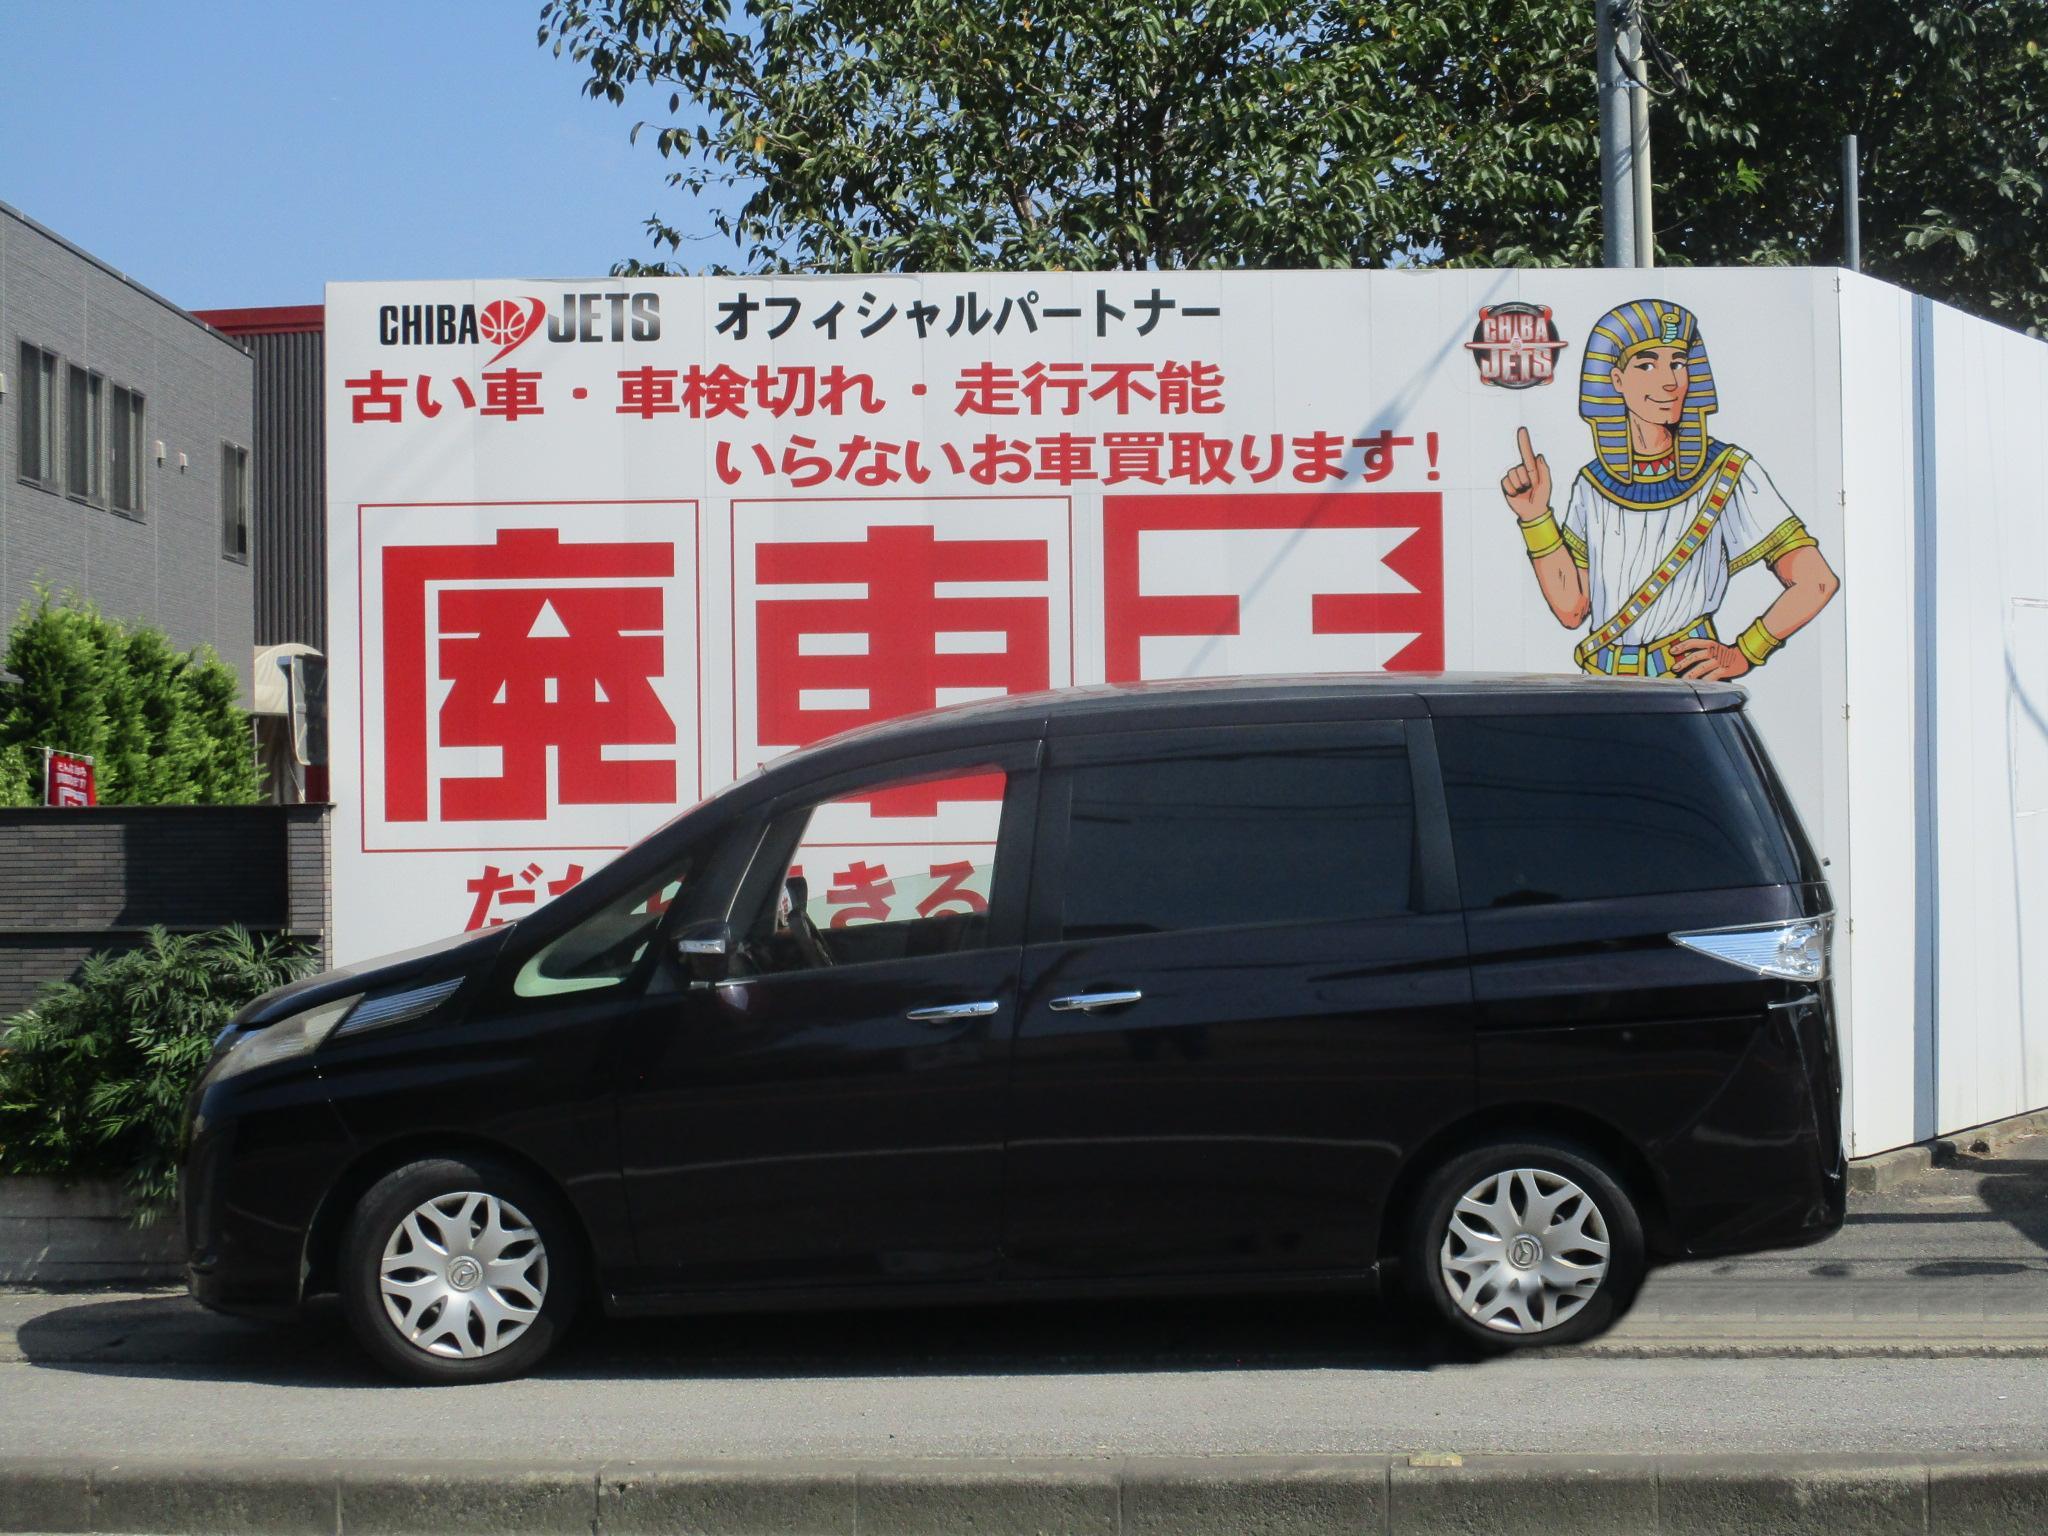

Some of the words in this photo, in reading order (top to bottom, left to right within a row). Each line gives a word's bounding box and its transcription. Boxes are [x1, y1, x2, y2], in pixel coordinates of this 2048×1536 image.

[379, 303, 480, 346] CHIBA
[547, 292, 661, 344] JETS
[714, 287, 1221, 341] オフィシャルパートナー
[1483, 314, 1549, 342] CHIBA
[1481, 348, 1553, 381] JETS
[345, 361, 1224, 423] 古い車・車検切れ・走行不能
[716, 431, 1441, 488] いらないお車買取ります!
